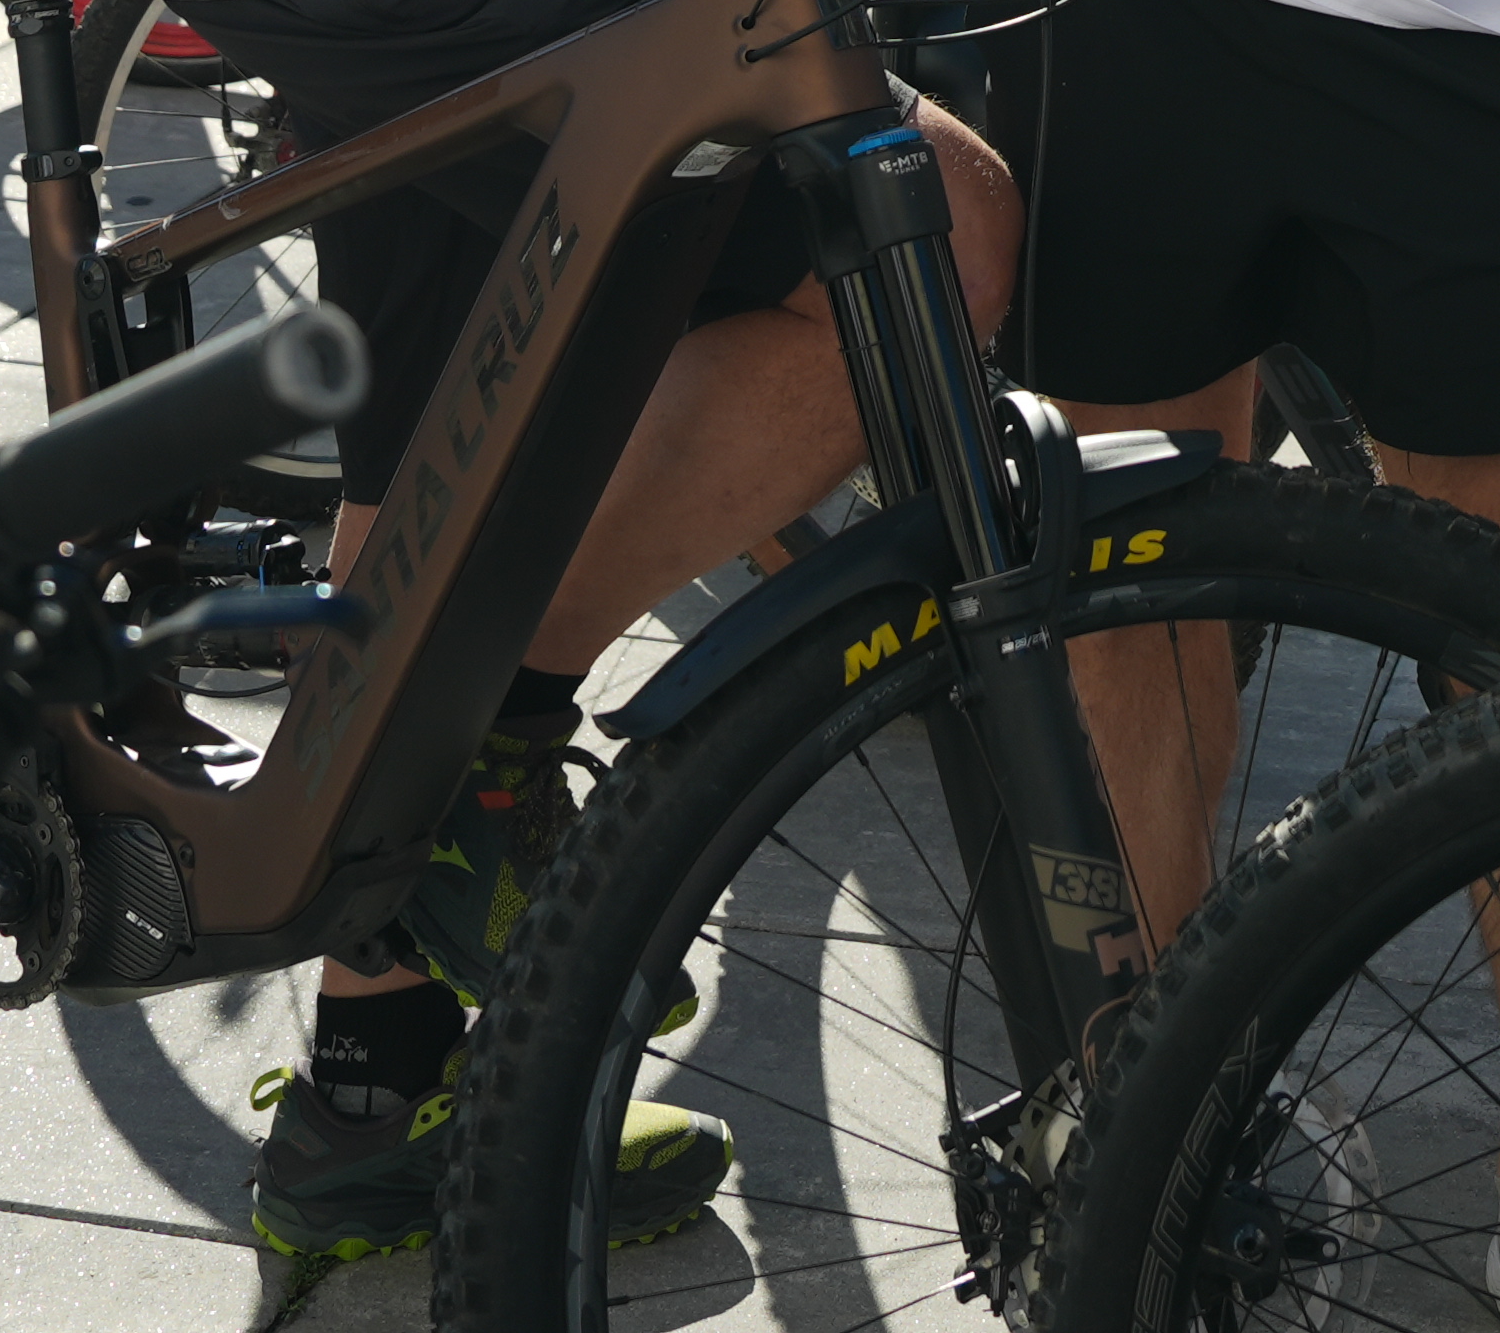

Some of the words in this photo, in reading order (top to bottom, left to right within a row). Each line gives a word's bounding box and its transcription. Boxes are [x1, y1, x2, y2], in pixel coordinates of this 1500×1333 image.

[449, 179, 580, 466] CRUZ
[844, 529, 1168, 687] MAIS
[1054, 861, 1121, 911] 38
